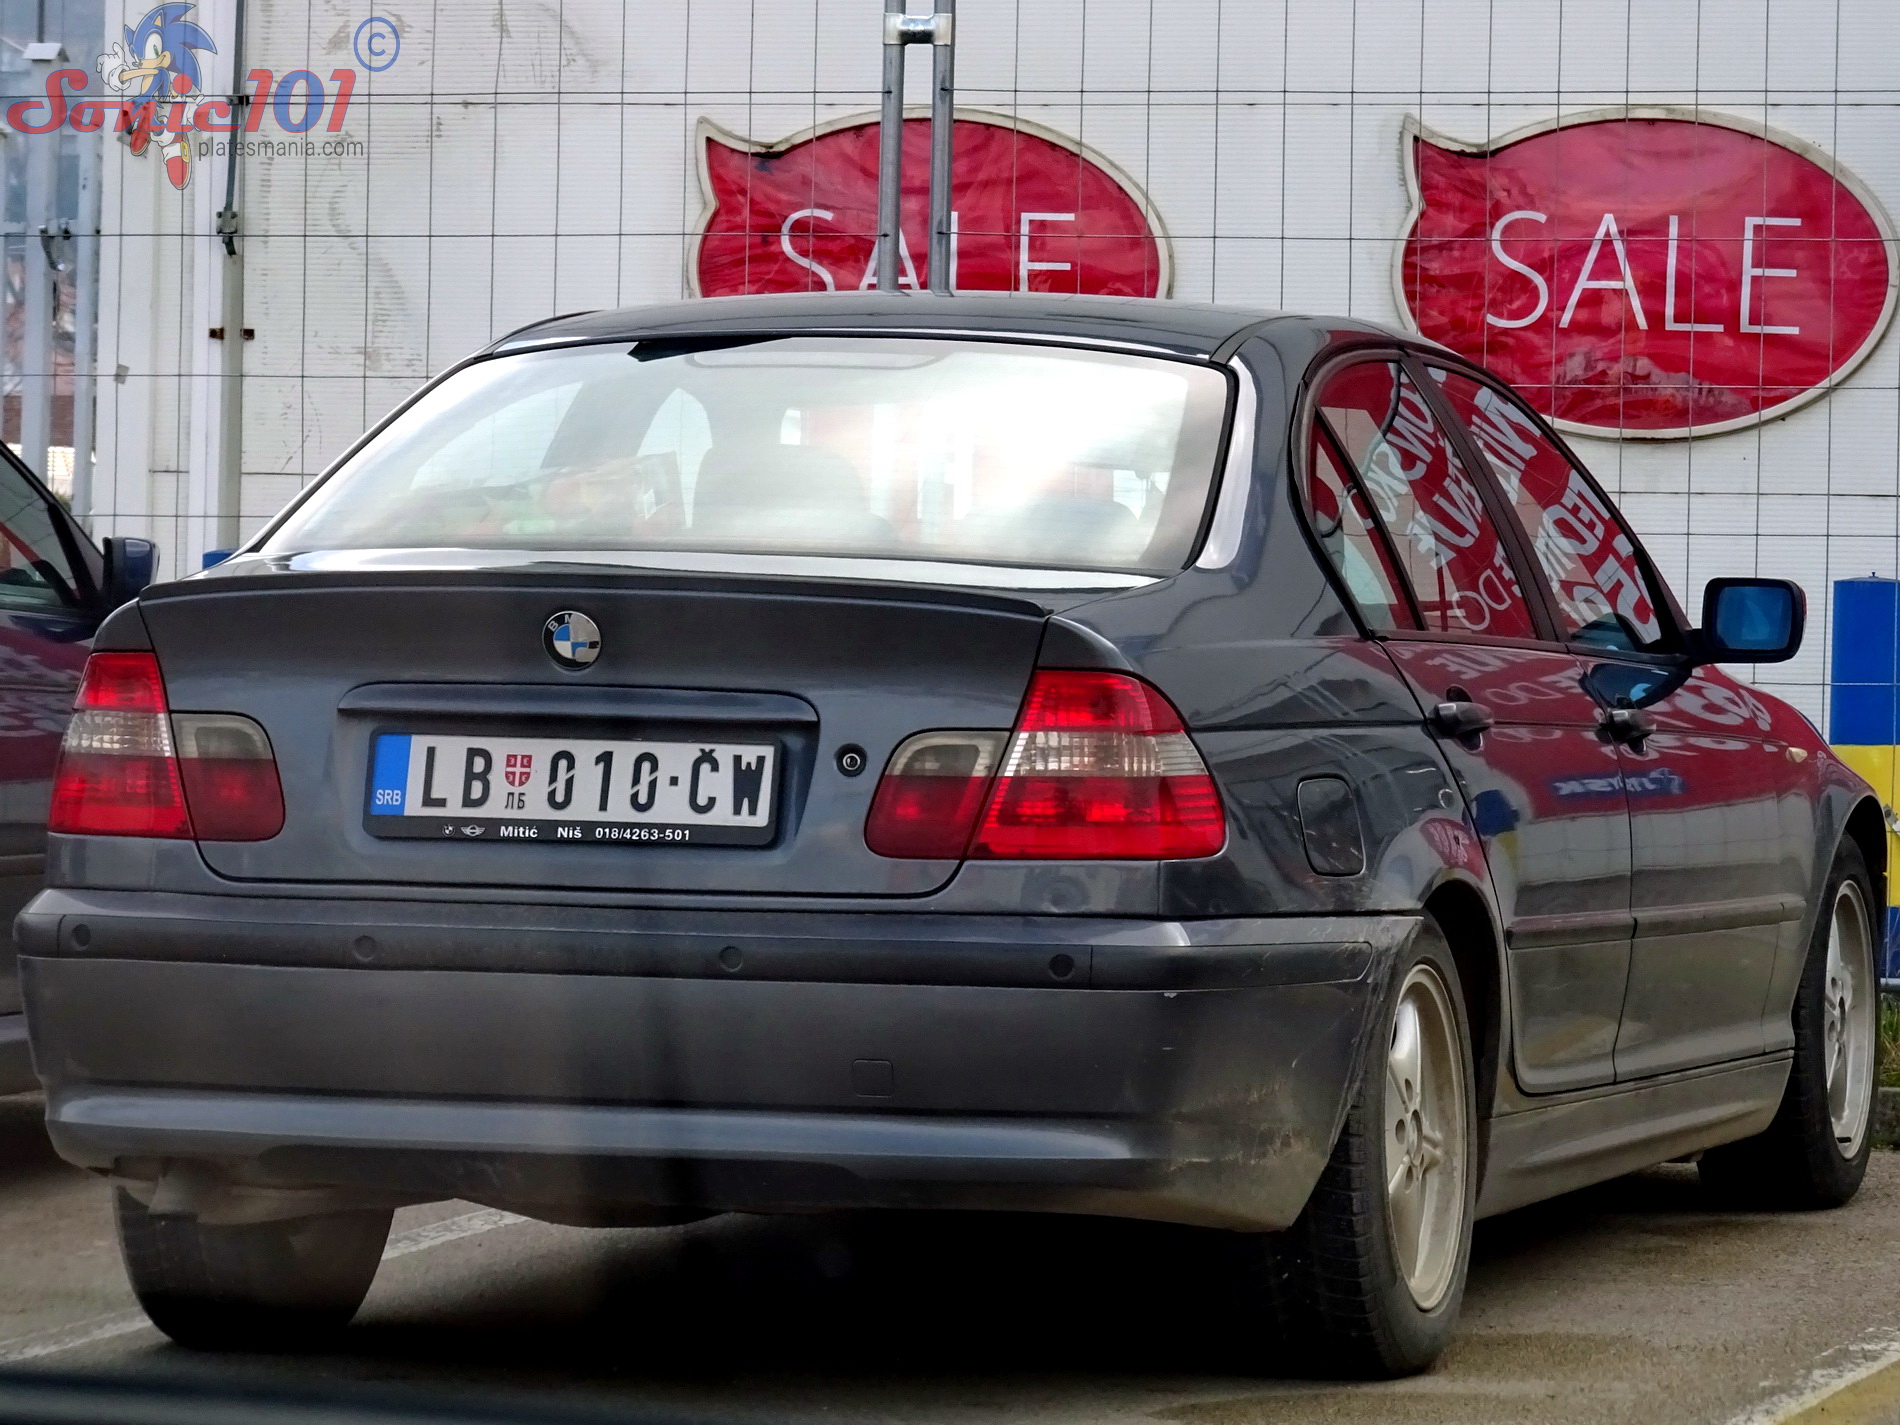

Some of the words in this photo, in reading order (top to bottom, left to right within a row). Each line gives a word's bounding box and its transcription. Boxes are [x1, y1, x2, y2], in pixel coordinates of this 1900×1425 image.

[1486, 210, 1802, 335] SALE
[421, 746, 493, 809] LB
[375, 789, 402, 806] SRB
[505, 791, 527, 810] ЛБ
[499, 825, 539, 839] Mitić
[557, 826, 583, 839] Niš
[595, 827, 691, 841] 018/4263-501
